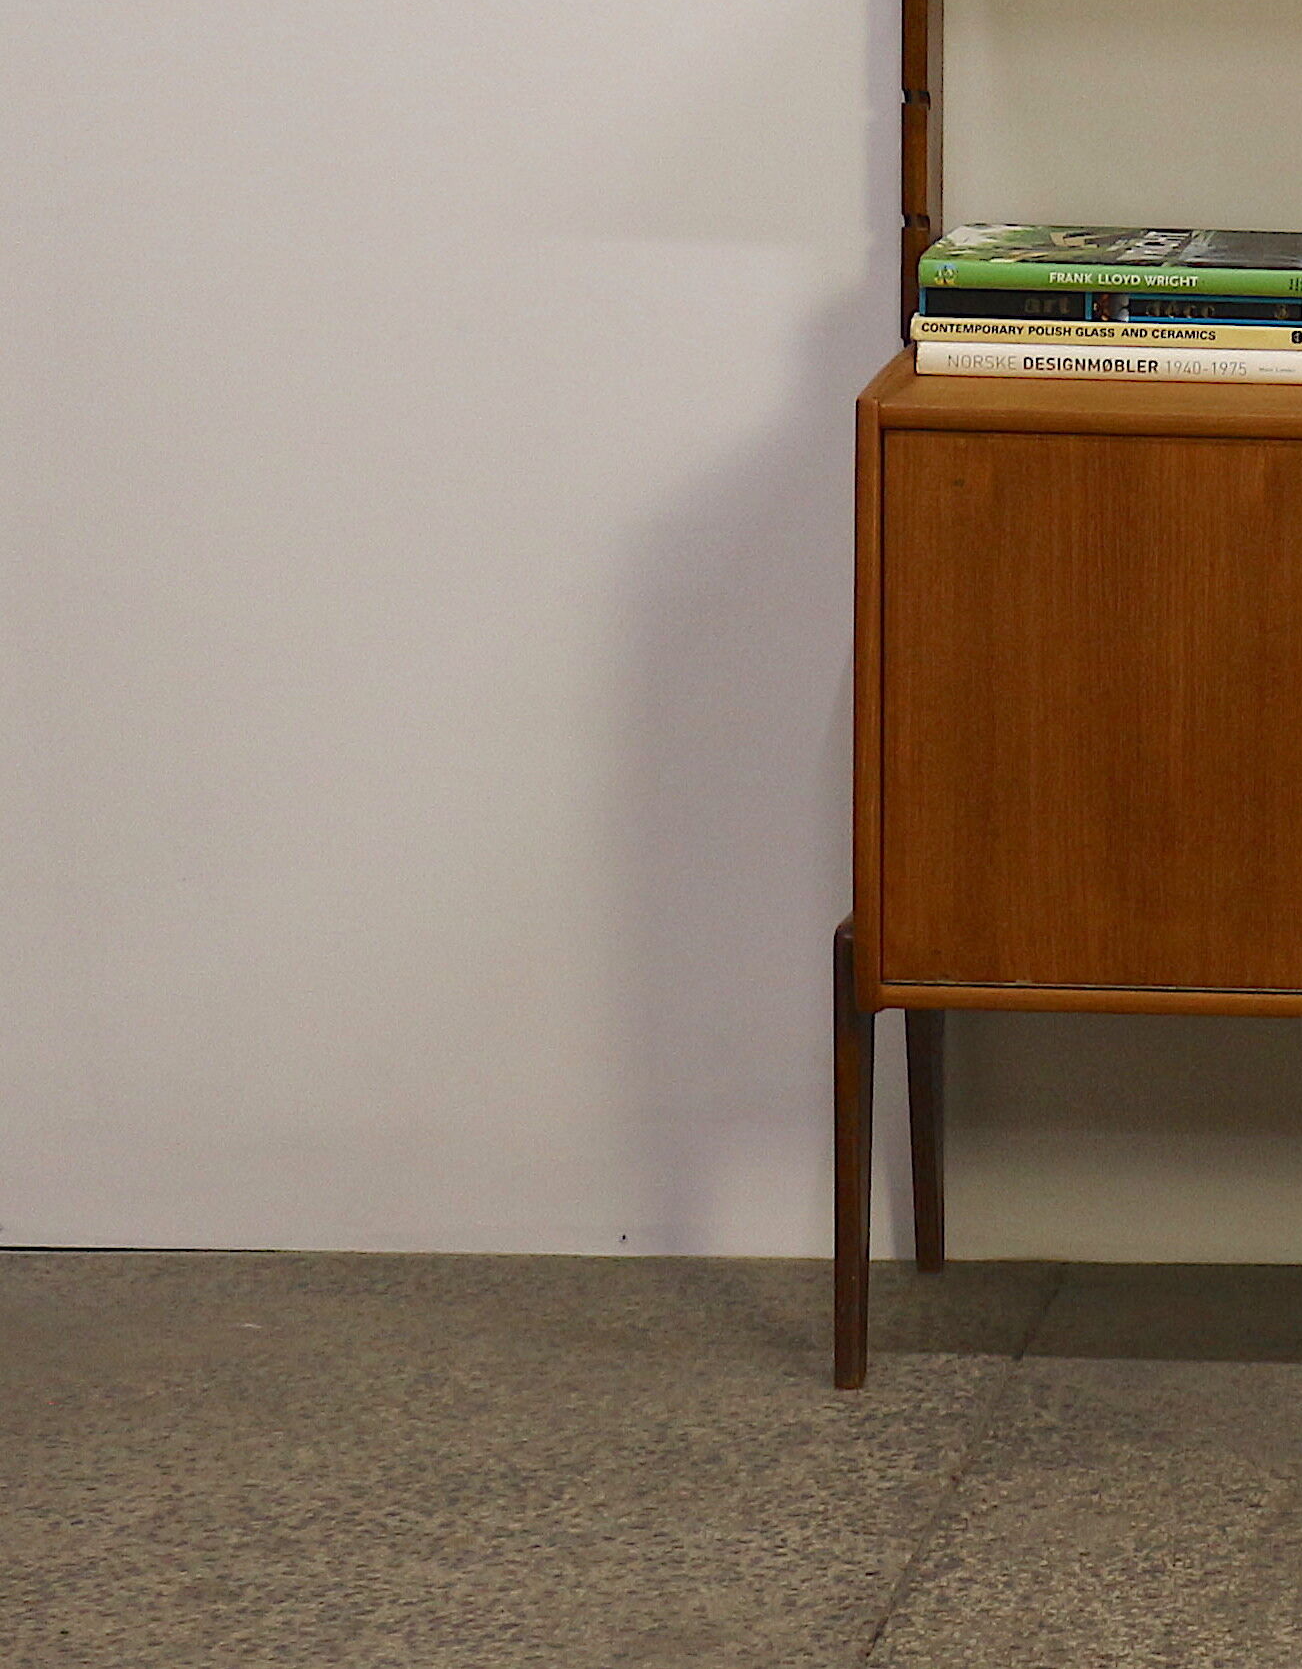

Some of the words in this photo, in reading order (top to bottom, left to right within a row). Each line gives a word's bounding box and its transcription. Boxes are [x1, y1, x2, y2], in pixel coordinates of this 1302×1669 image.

[1049, 272, 1093, 284] FRANK
[1098, 273, 1140, 285] LLOYD
[1145, 276, 1199, 287] WRIGHT
[921, 322, 1024, 335] CONTEMPORARY
[1028, 326, 1072, 337] POLISH
[1075, 327, 1115, 338] GLASS
[1122, 328, 1148, 339] AND
[1151, 329, 1216, 341] CERAMICS
[947, 354, 1017, 371] NORSKE
[1023, 356, 1158, 374] DESIGNMØBLER
[1165, 360, 1247, 377] 1940-1975
